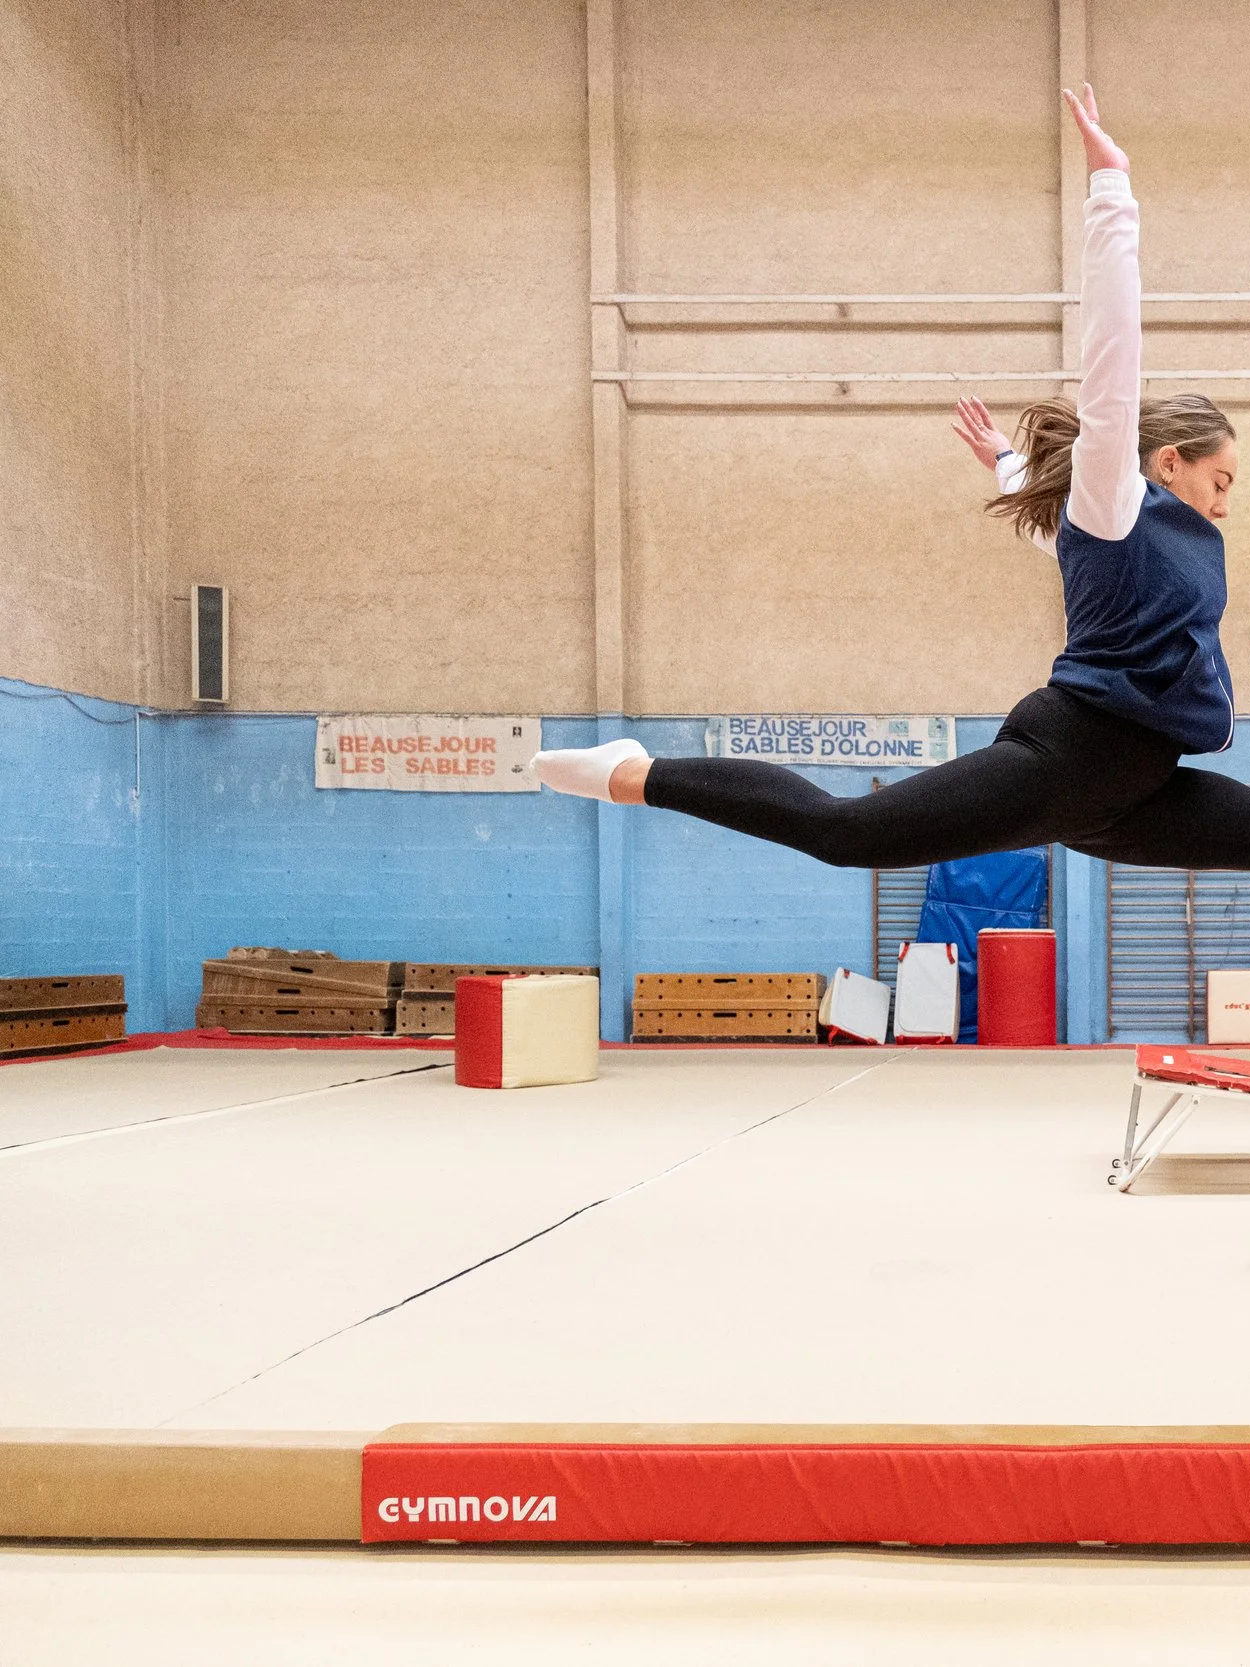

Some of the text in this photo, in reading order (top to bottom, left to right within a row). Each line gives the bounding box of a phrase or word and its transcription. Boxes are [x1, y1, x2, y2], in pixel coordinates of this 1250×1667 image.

[729, 718, 867, 737] BEAUSEJOUR
[338, 735, 497, 754] BEAUSEJOUR
[731, 736, 923, 757] SABLES D'OLONNE
[341, 757, 496, 776] LES SABLES
[378, 1495, 557, 1523] GYMNOVA
